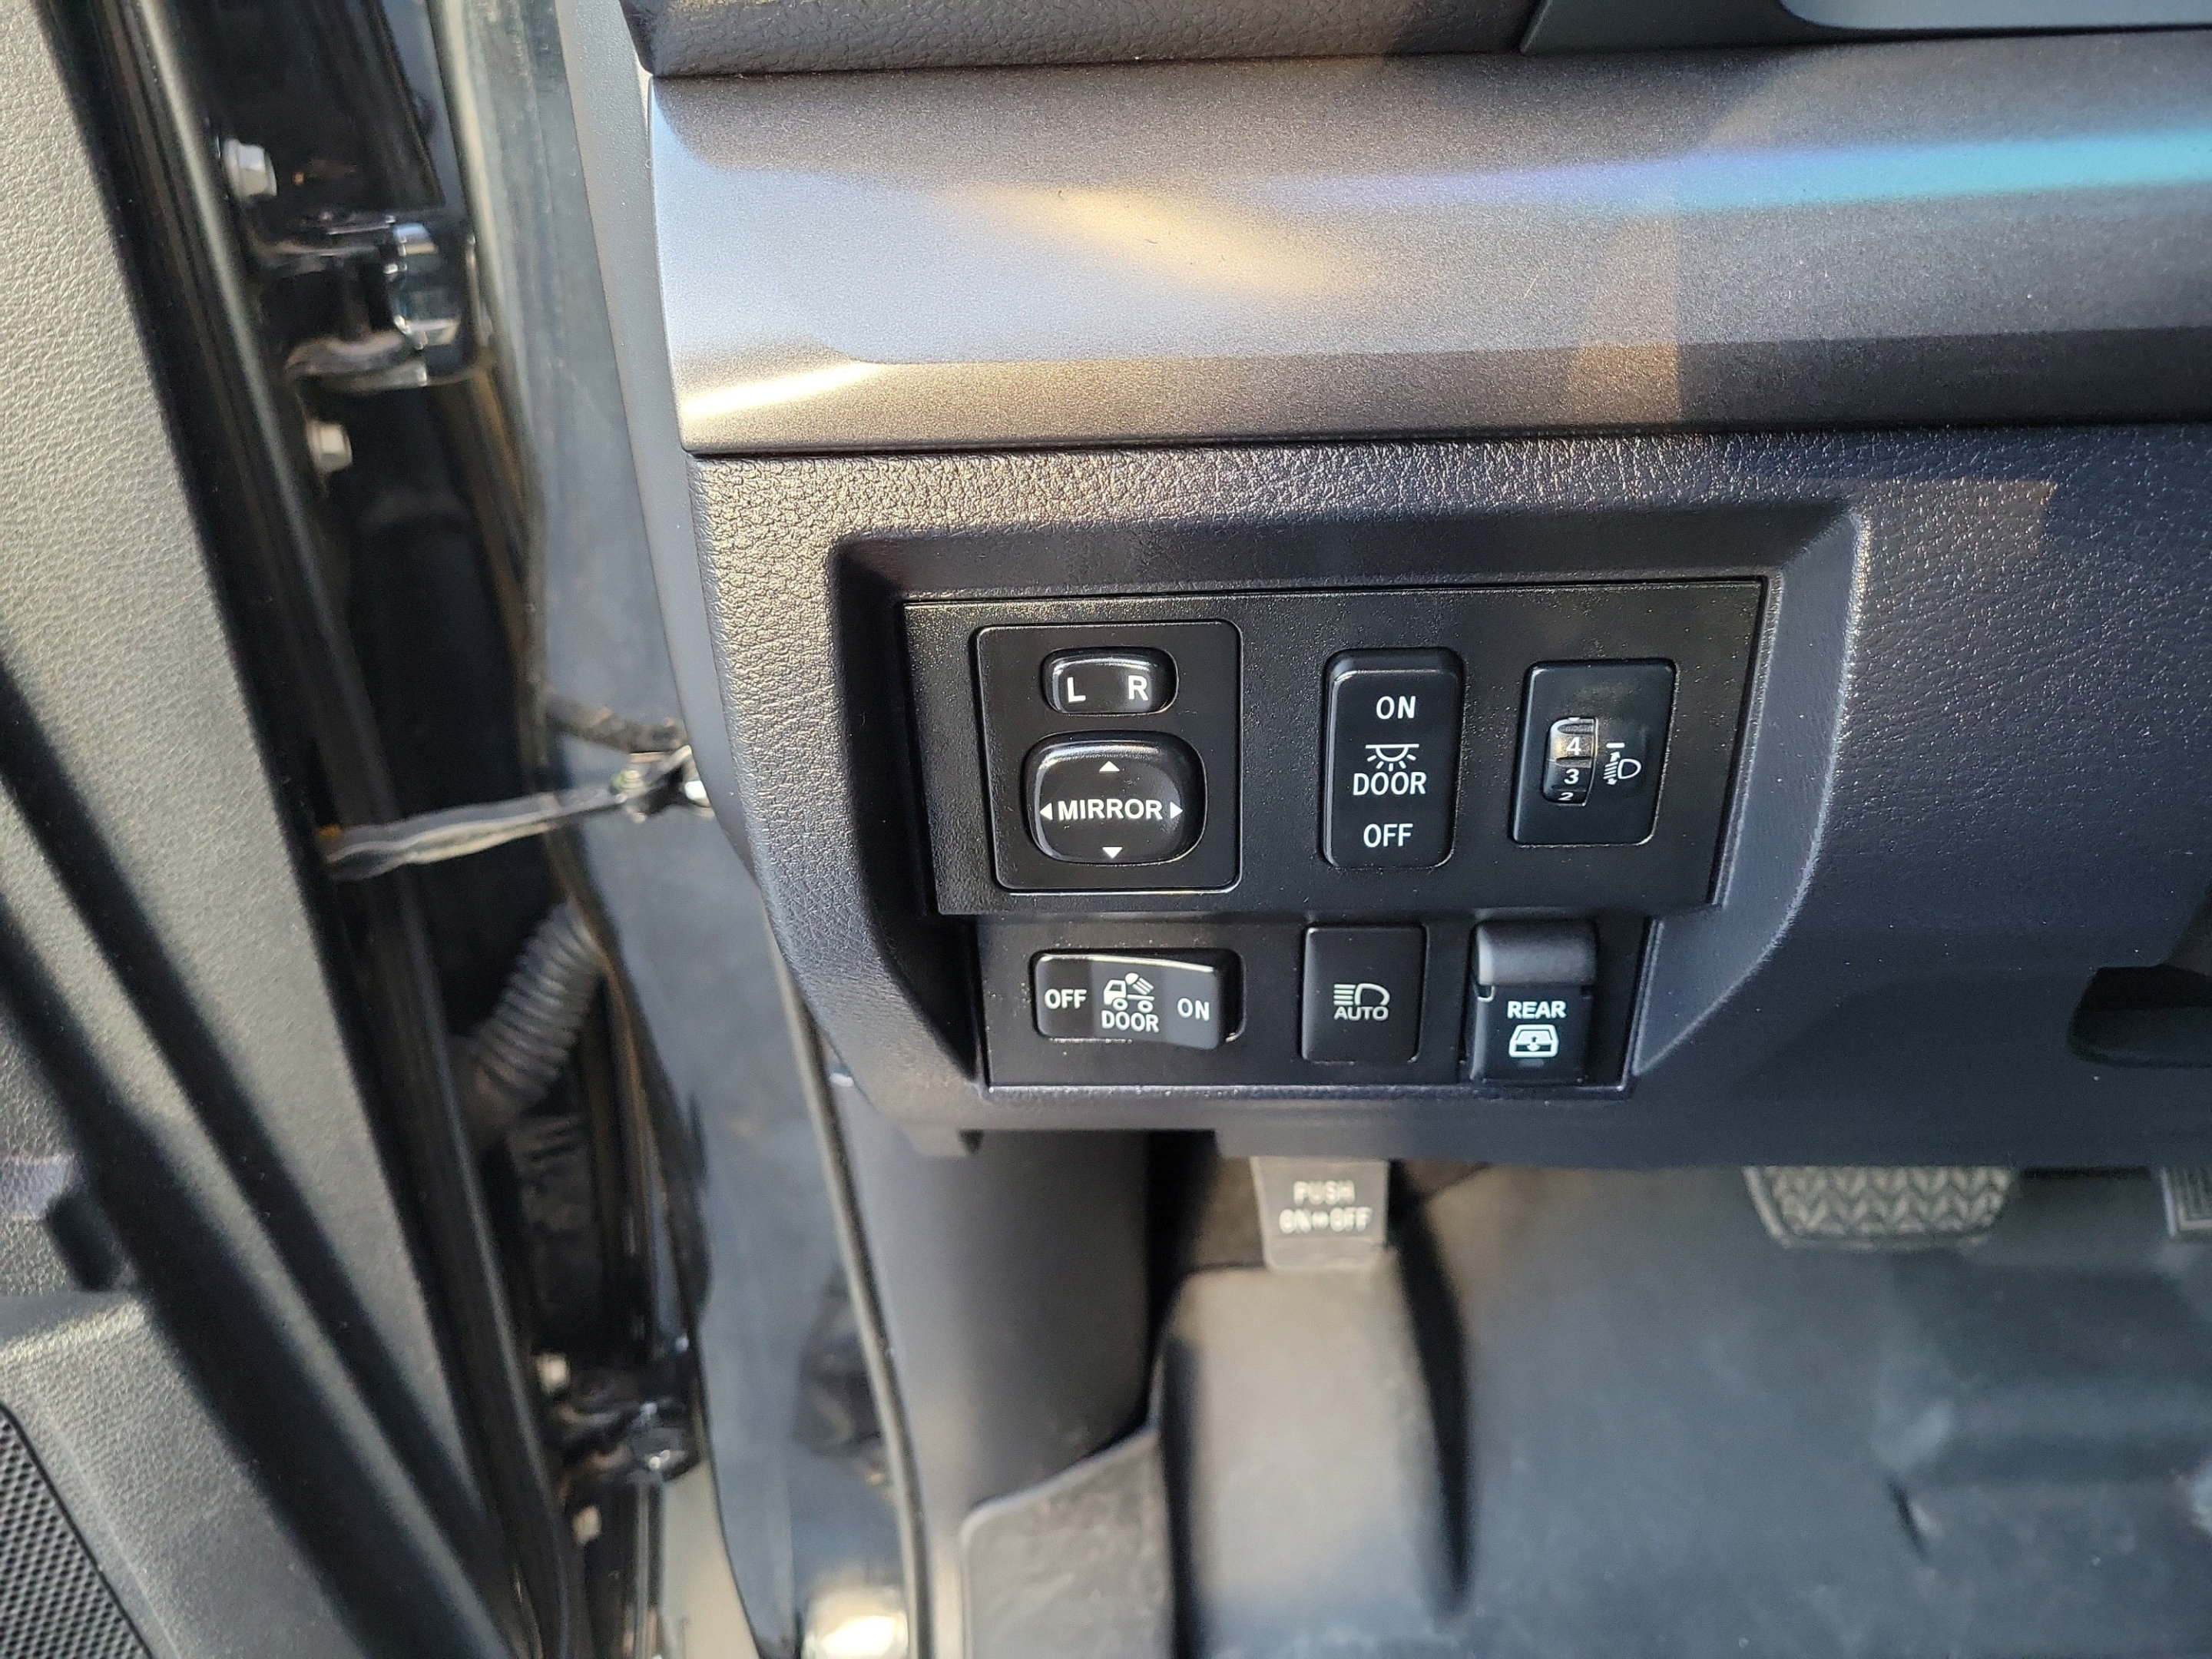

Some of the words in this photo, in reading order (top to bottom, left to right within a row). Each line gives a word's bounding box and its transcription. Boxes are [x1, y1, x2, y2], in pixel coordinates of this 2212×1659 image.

[1066, 677, 1086, 703] L
[1128, 675, 1149, 700] R
[1376, 696, 1416, 719] ON
[1565, 737, 1582, 756] 4
[1353, 771, 1427, 796] DOOR
[1564, 768, 1580, 784] 3
[1558, 792, 1575, 801] 2
[1058, 799, 1164, 821] MIRROR
[1363, 823, 1413, 848] OFF
[1044, 988, 1087, 1010] OFF
[1177, 998, 1210, 1021] ON
[1507, 1000, 1567, 1019] REAR
[1101, 1010, 1160, 1032] DOOR
[1333, 1005, 1389, 1022] AUTO
[1293, 1181, 1356, 1206] PUSH
